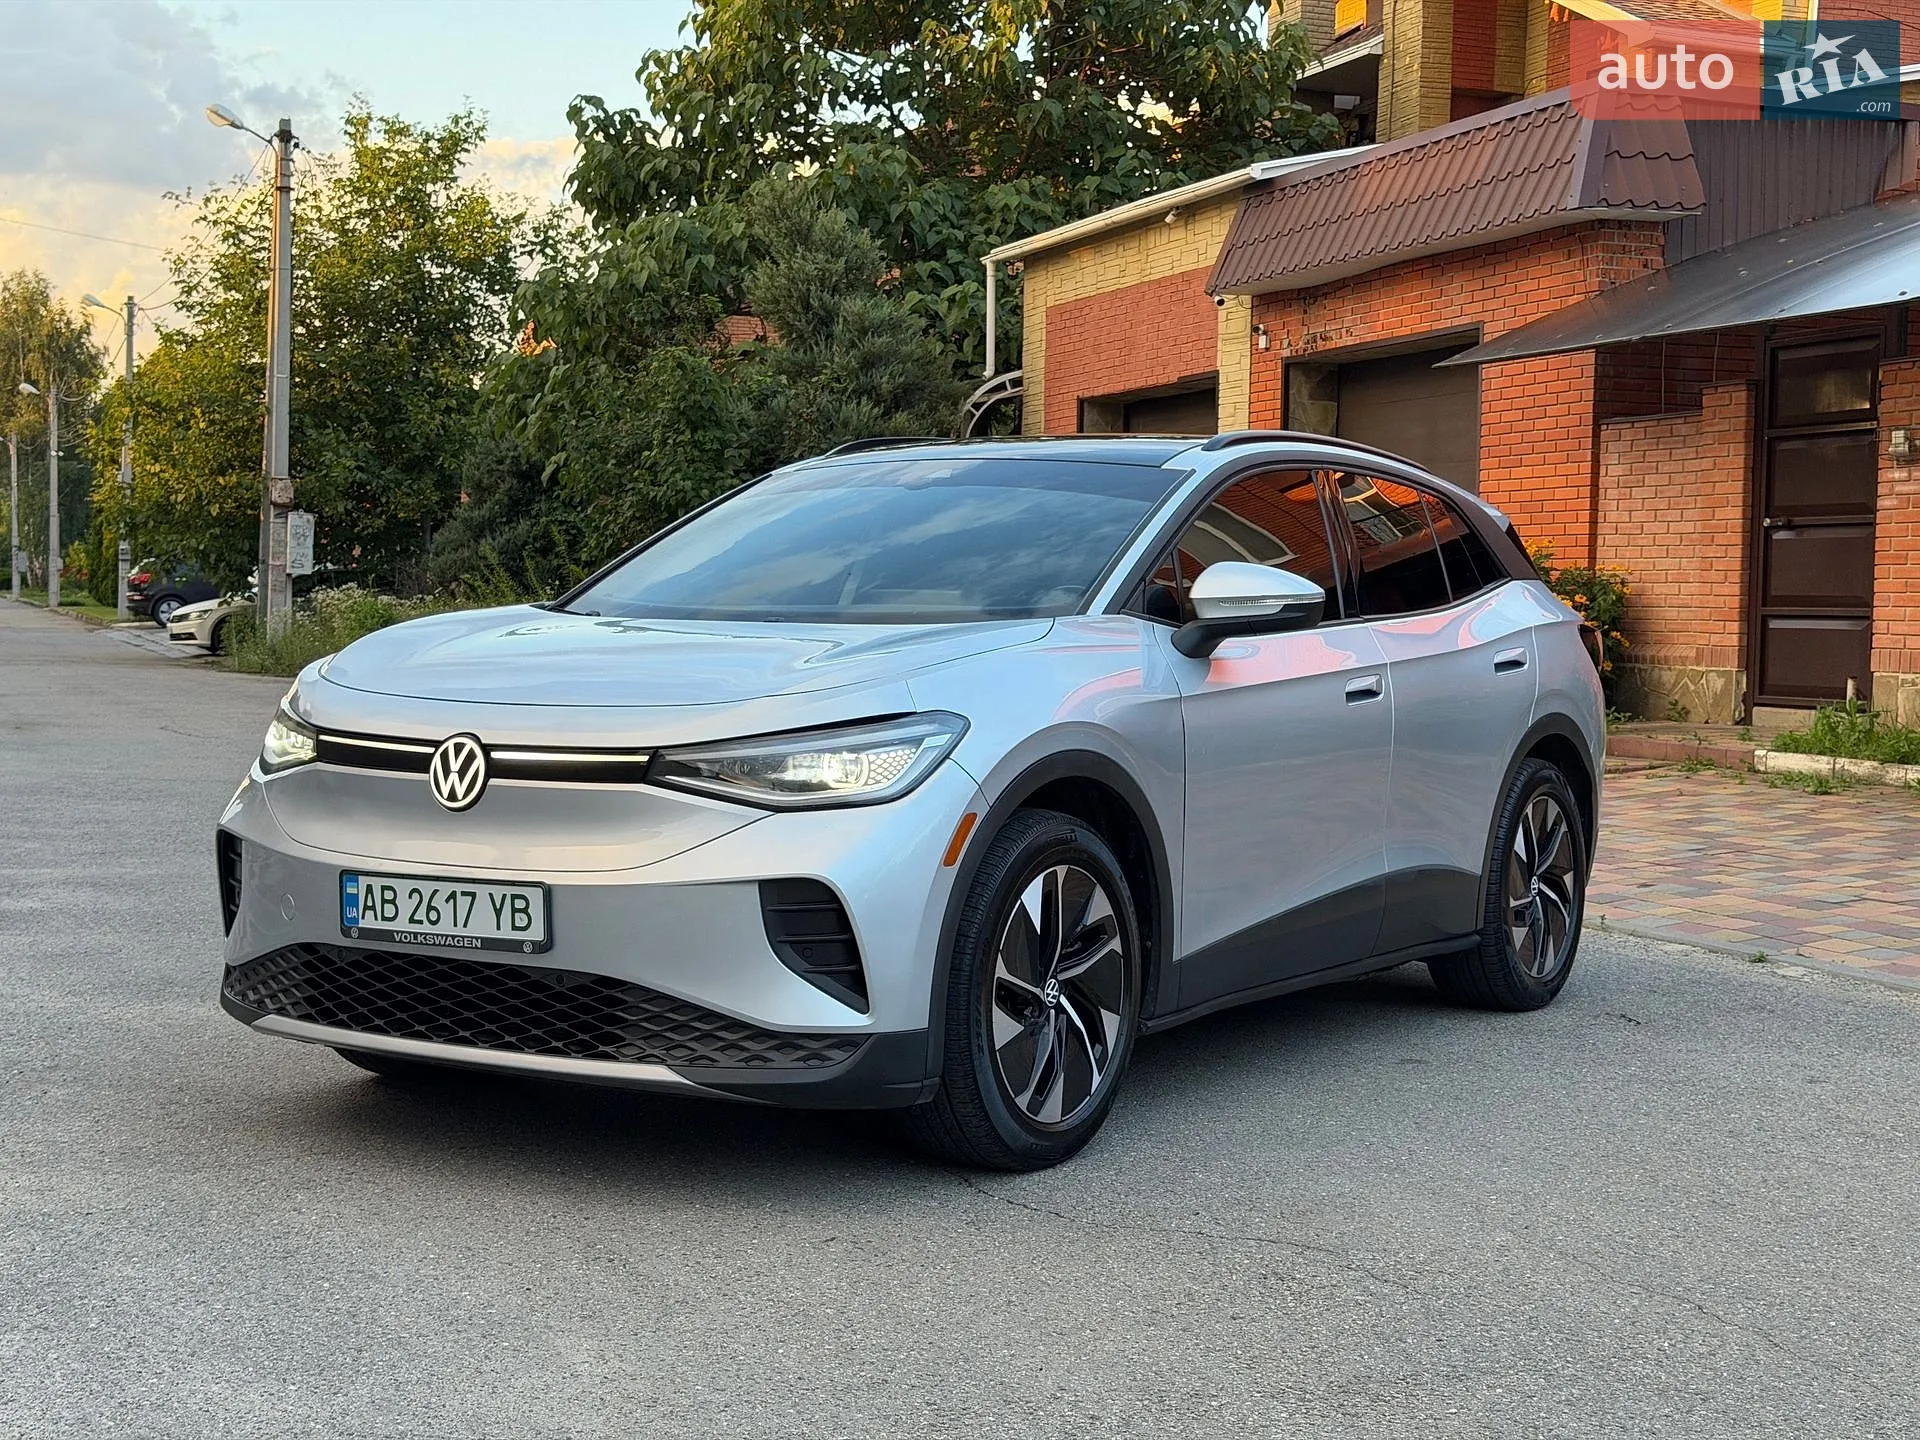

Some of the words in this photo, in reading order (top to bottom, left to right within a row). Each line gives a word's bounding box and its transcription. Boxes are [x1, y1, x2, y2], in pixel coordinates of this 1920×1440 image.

[346, 908, 358, 919] UA
[361, 883, 399, 922] AB
[408, 887, 477, 929] 2617
[488, 892, 533, 932] YB
[393, 932, 482, 948] VOLKSWAGEN
